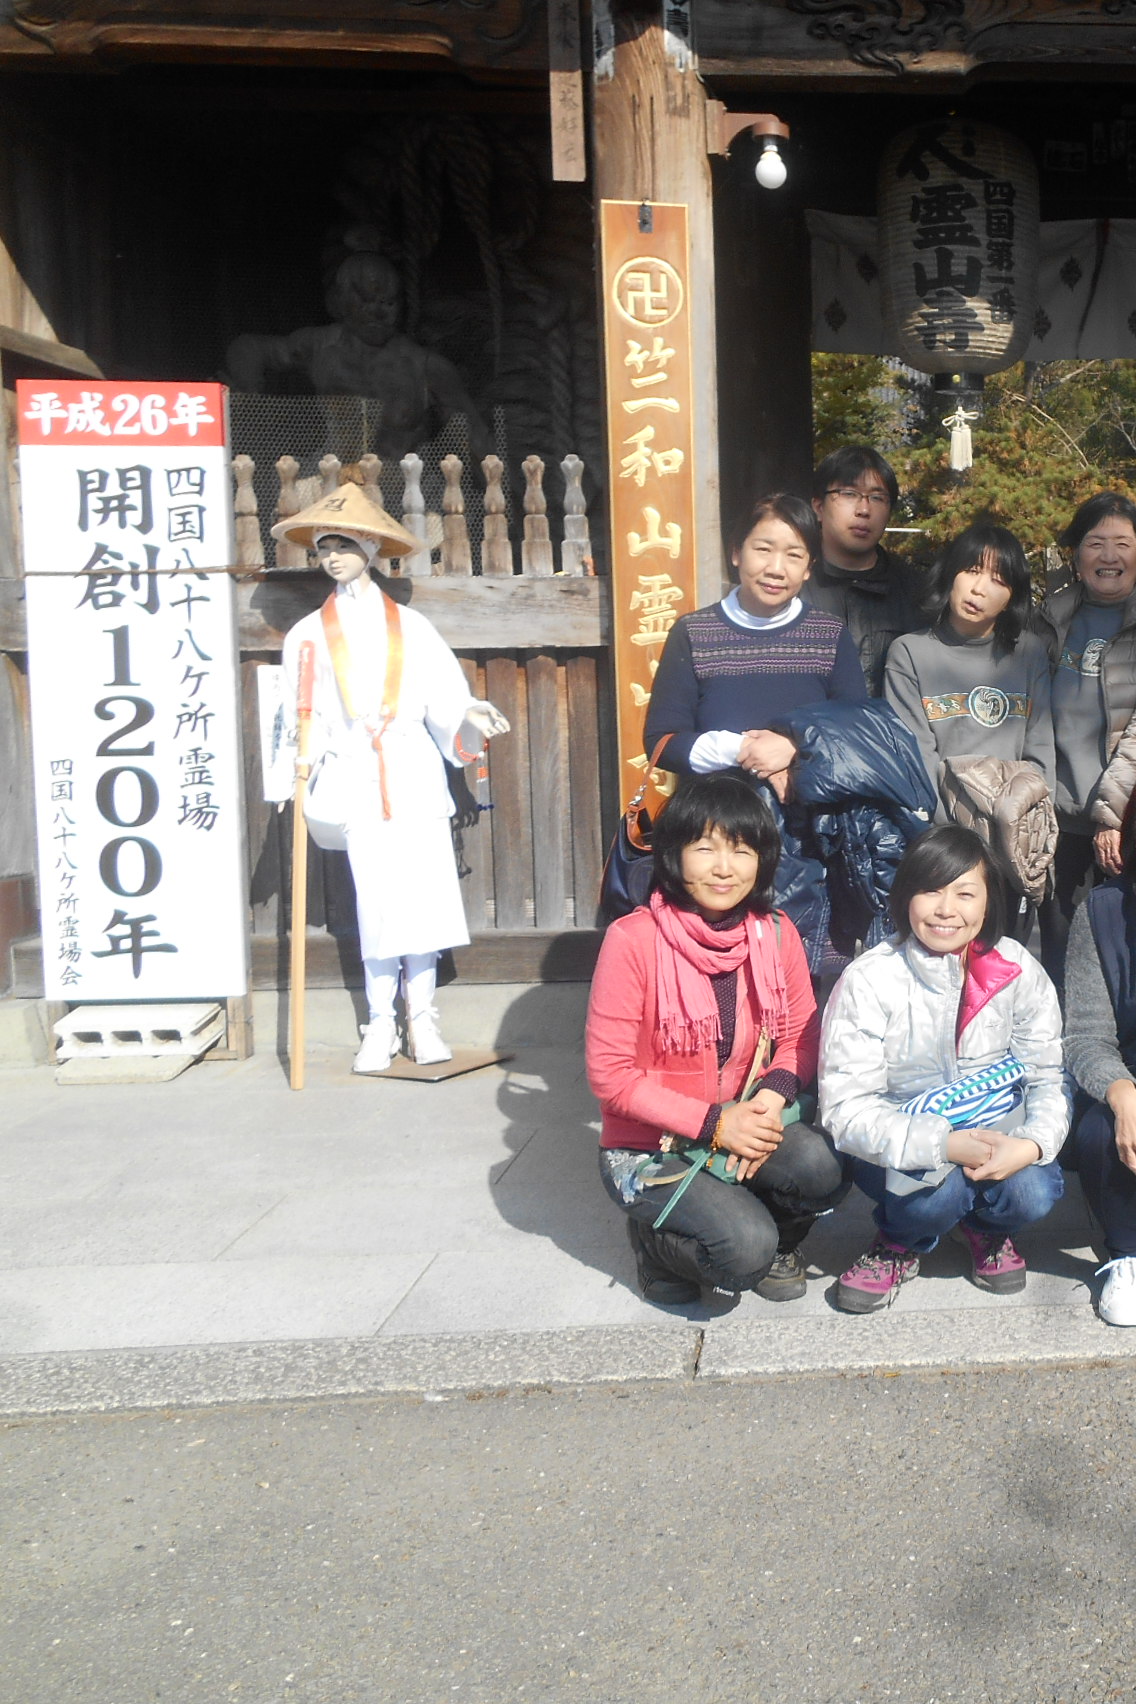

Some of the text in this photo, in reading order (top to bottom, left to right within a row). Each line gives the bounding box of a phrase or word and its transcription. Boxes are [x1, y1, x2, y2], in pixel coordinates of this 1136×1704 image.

[24, 392, 215, 437] 平成26年
[619, 336, 687, 796] 竺和山霊
[74, 463, 179, 980] 開創1200年
